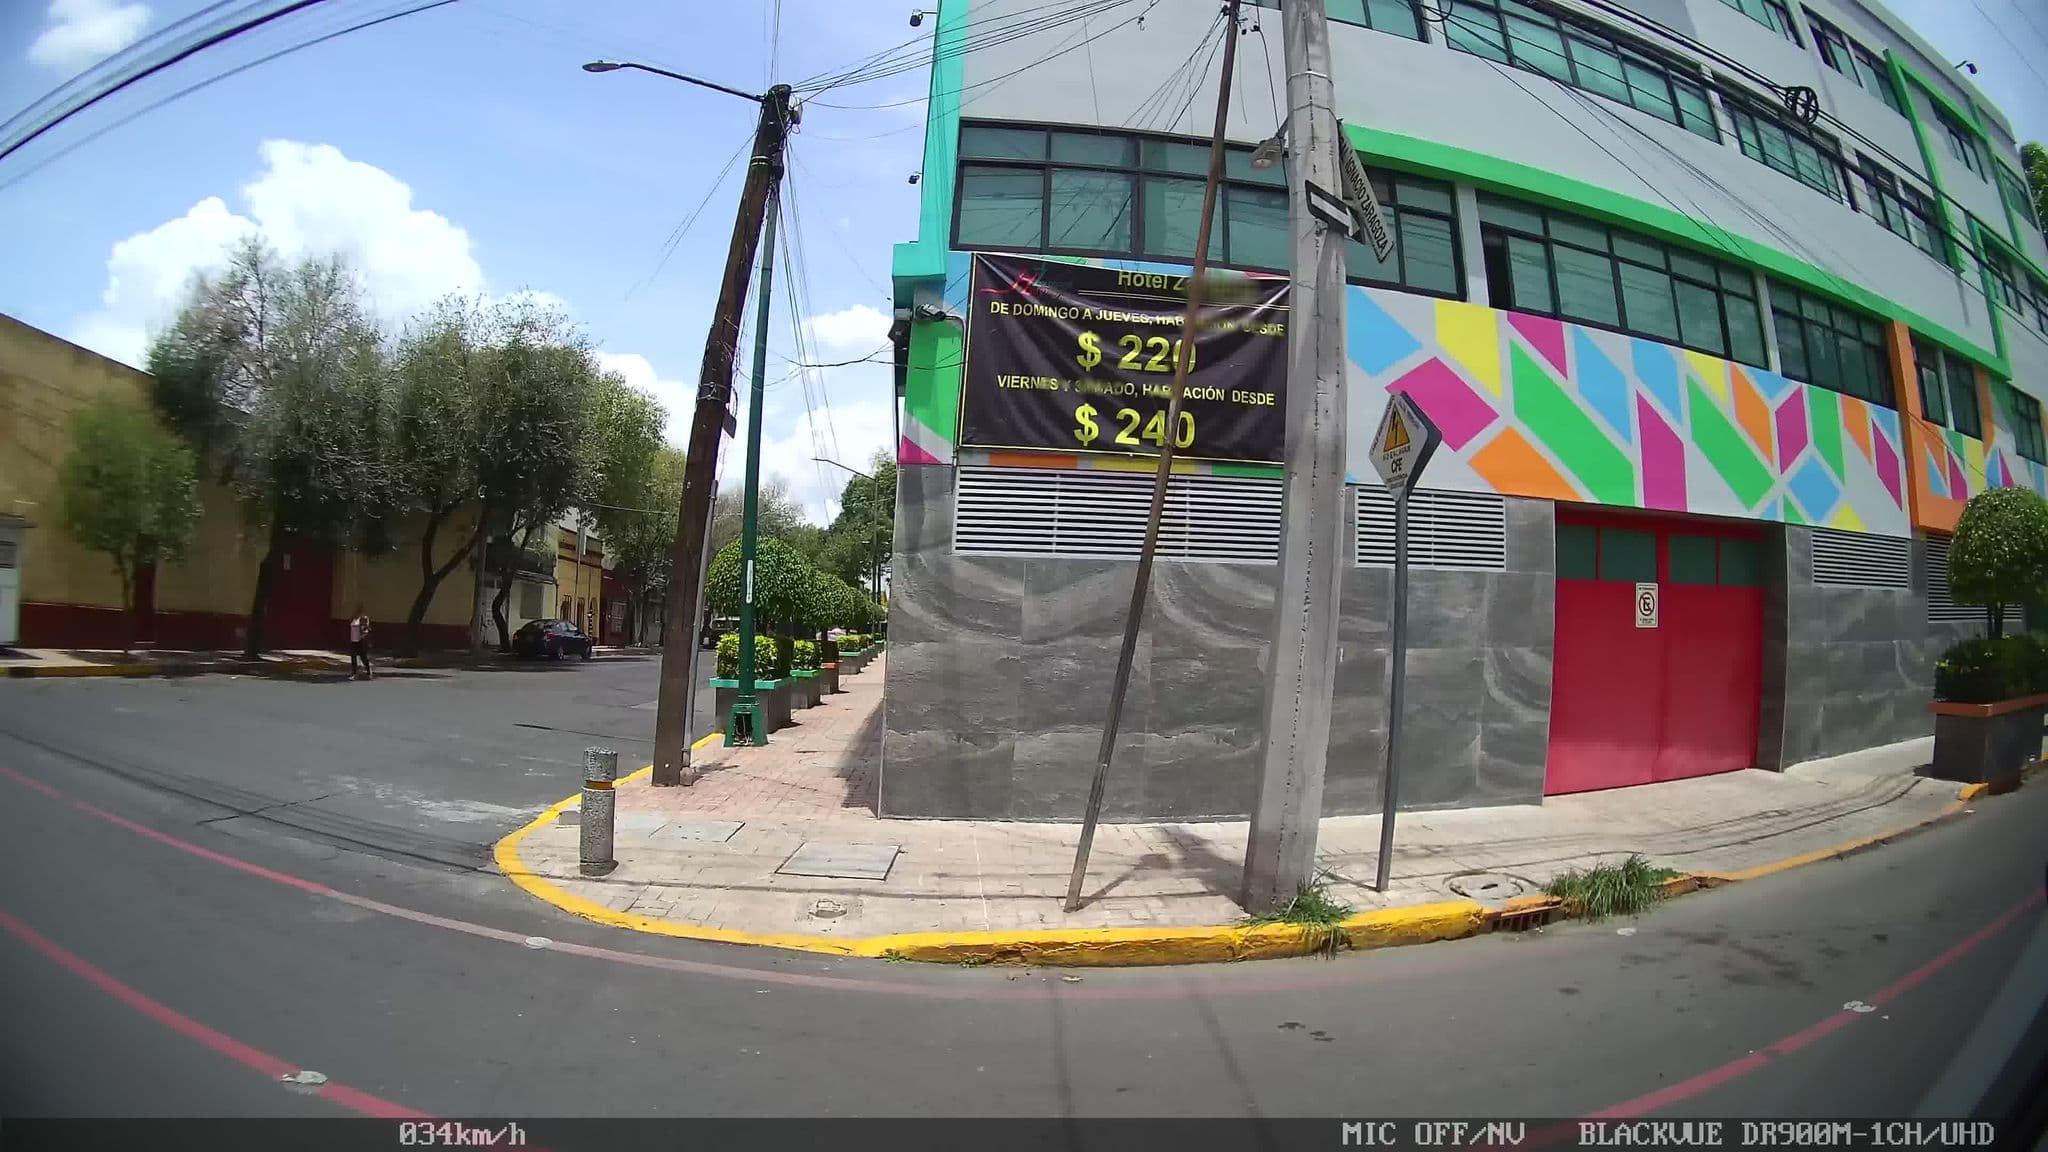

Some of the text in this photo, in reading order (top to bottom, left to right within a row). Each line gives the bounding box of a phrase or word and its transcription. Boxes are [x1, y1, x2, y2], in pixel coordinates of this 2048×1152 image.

[1361, 194, 1388, 254] ZARAGOZA
[1118, 271, 1168, 290] Hotel
[990, 301, 1009, 315] DE
[1013, 304, 1079, 320] DOMINGO
[1082, 309, 1093, 320] A
[1095, 310, 1153, 325] JUEVES,
[1076, 331, 1197, 374] $ 220
[997, 375, 1059, 391] VIERNES
[1142, 383, 1225, 401] HABACIÓN
[1232, 390, 1276, 406] DESDE
[1073, 403, 1196, 448] $ 240
